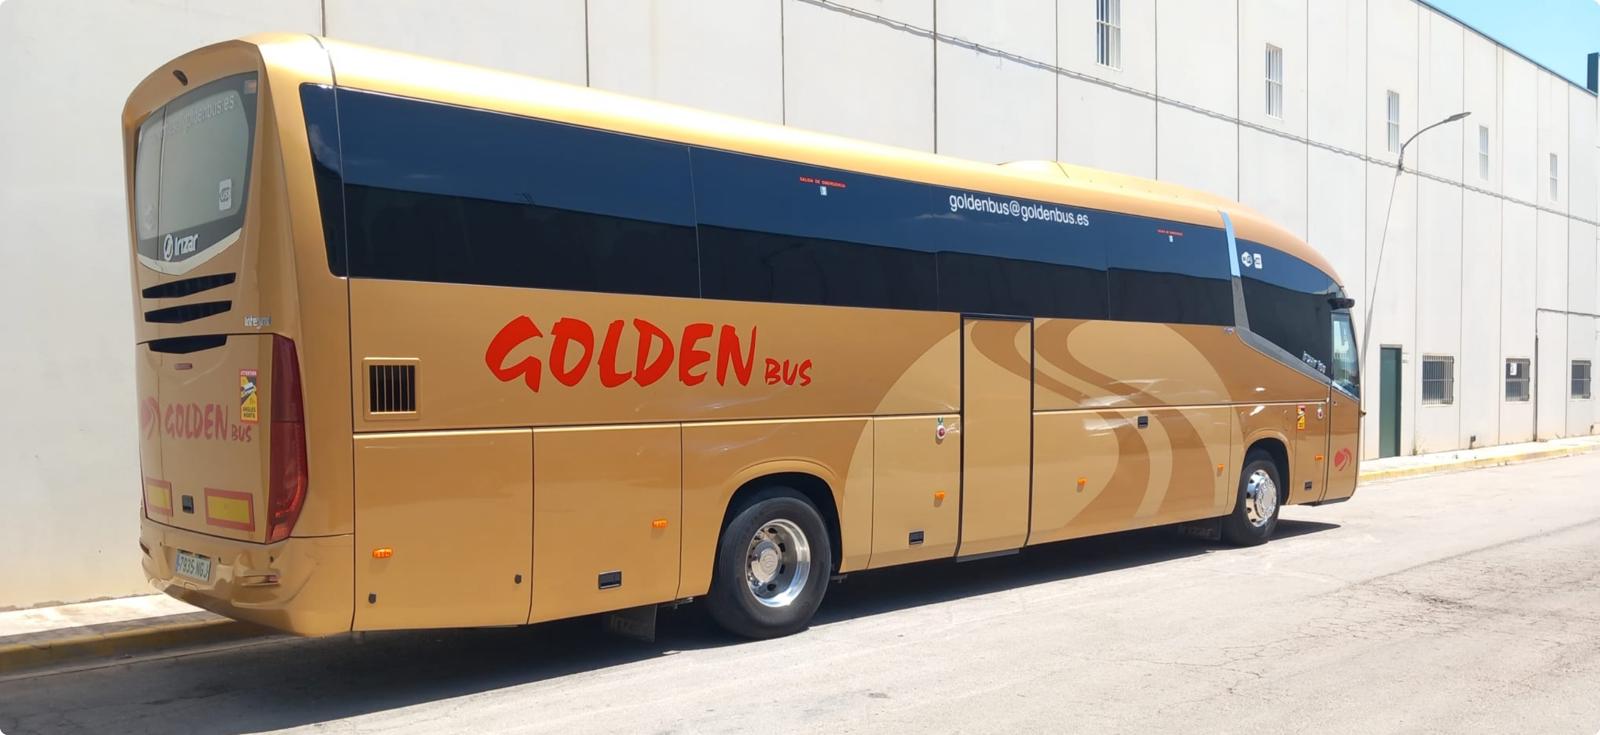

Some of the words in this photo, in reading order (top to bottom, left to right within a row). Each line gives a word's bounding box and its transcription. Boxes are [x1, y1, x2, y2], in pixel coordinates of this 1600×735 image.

[949, 193, 1090, 226] goldenbus@goldenbus.es
[485, 315, 757, 393] GOLDEN
[764, 358, 813, 387] BUS
[164, 402, 229, 441] GOLDEN
[231, 423, 253, 443] BUS
